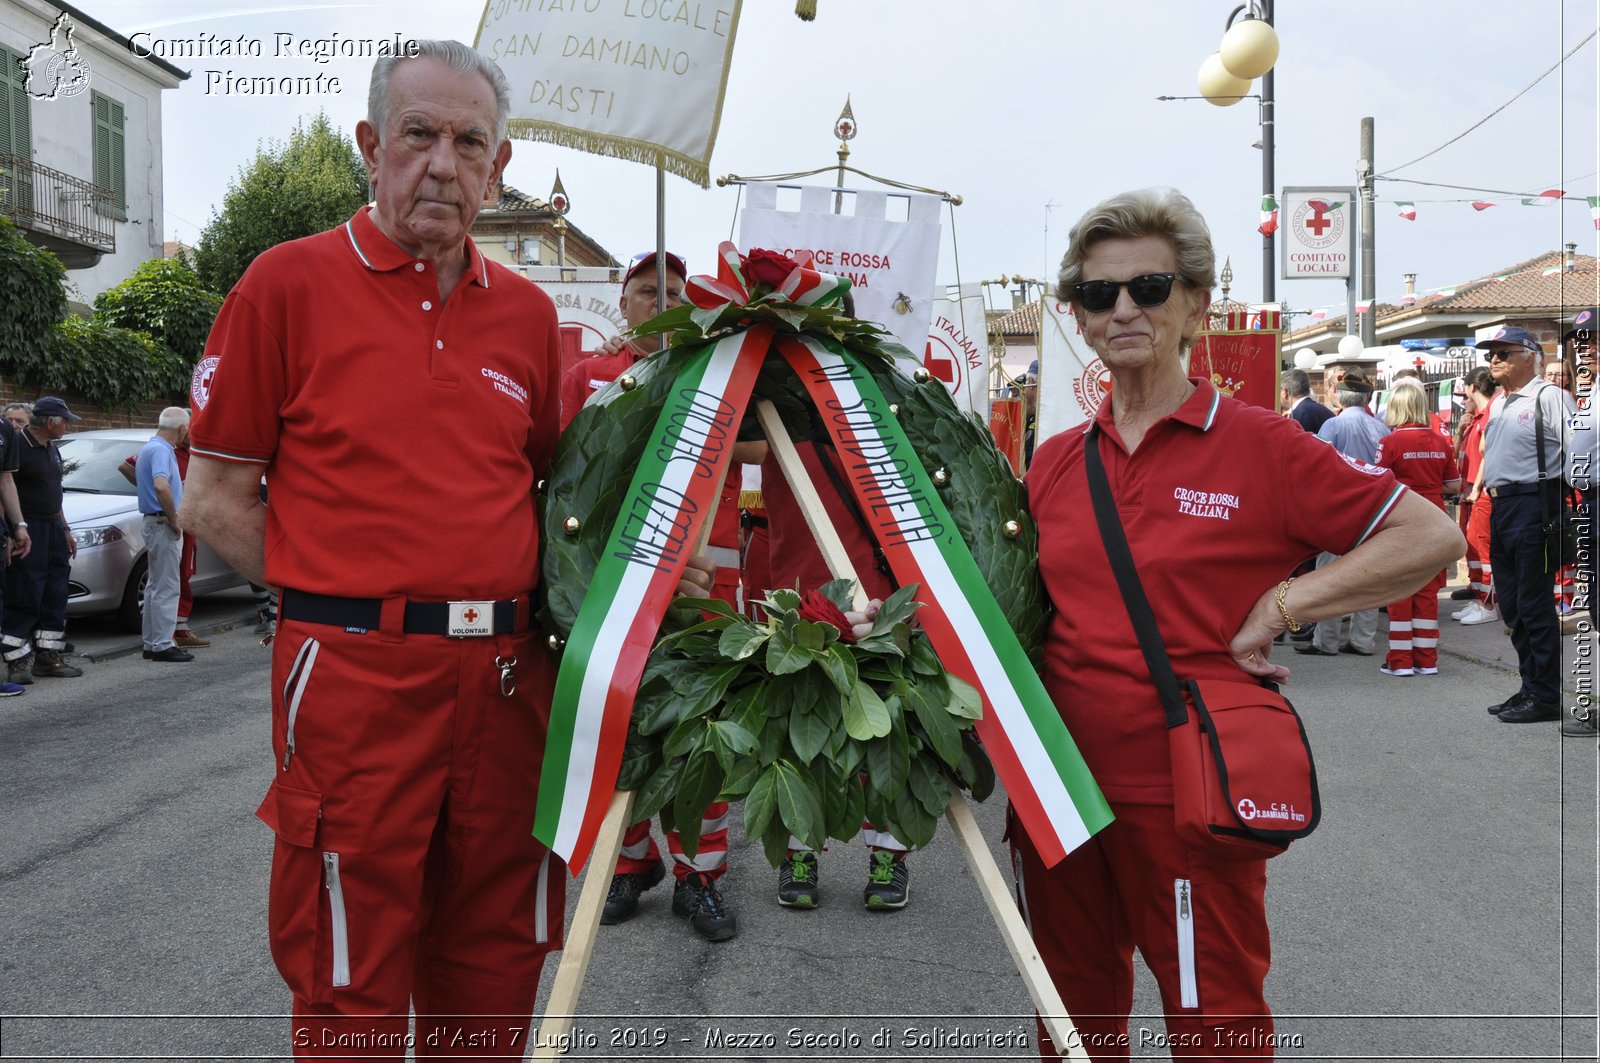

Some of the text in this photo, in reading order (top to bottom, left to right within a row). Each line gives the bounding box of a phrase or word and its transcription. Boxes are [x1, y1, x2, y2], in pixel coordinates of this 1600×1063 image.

[624, 0, 730, 37] LOCALE
[491, 32, 690, 76] SAN DAMIANO
[529, 79, 615, 118] D'ASTI
[784, 249, 891, 270] CCE ROSSA
[1291, 253, 1346, 262] COMITATO
[1297, 264, 1340, 272] LOCALE
[554, 294, 582, 309] SSA
[935, 316, 983, 370] ITALIANA
[481, 368, 509, 385] CROCE
[807, 364, 864, 383] DI
[1403, 452, 1417, 460] CROCE
[614, 388, 736, 573] MEZZO SECOLO
[1174, 487, 1239, 508] CROCE ROSSA
[1179, 500, 1230, 520] ITALIANA
